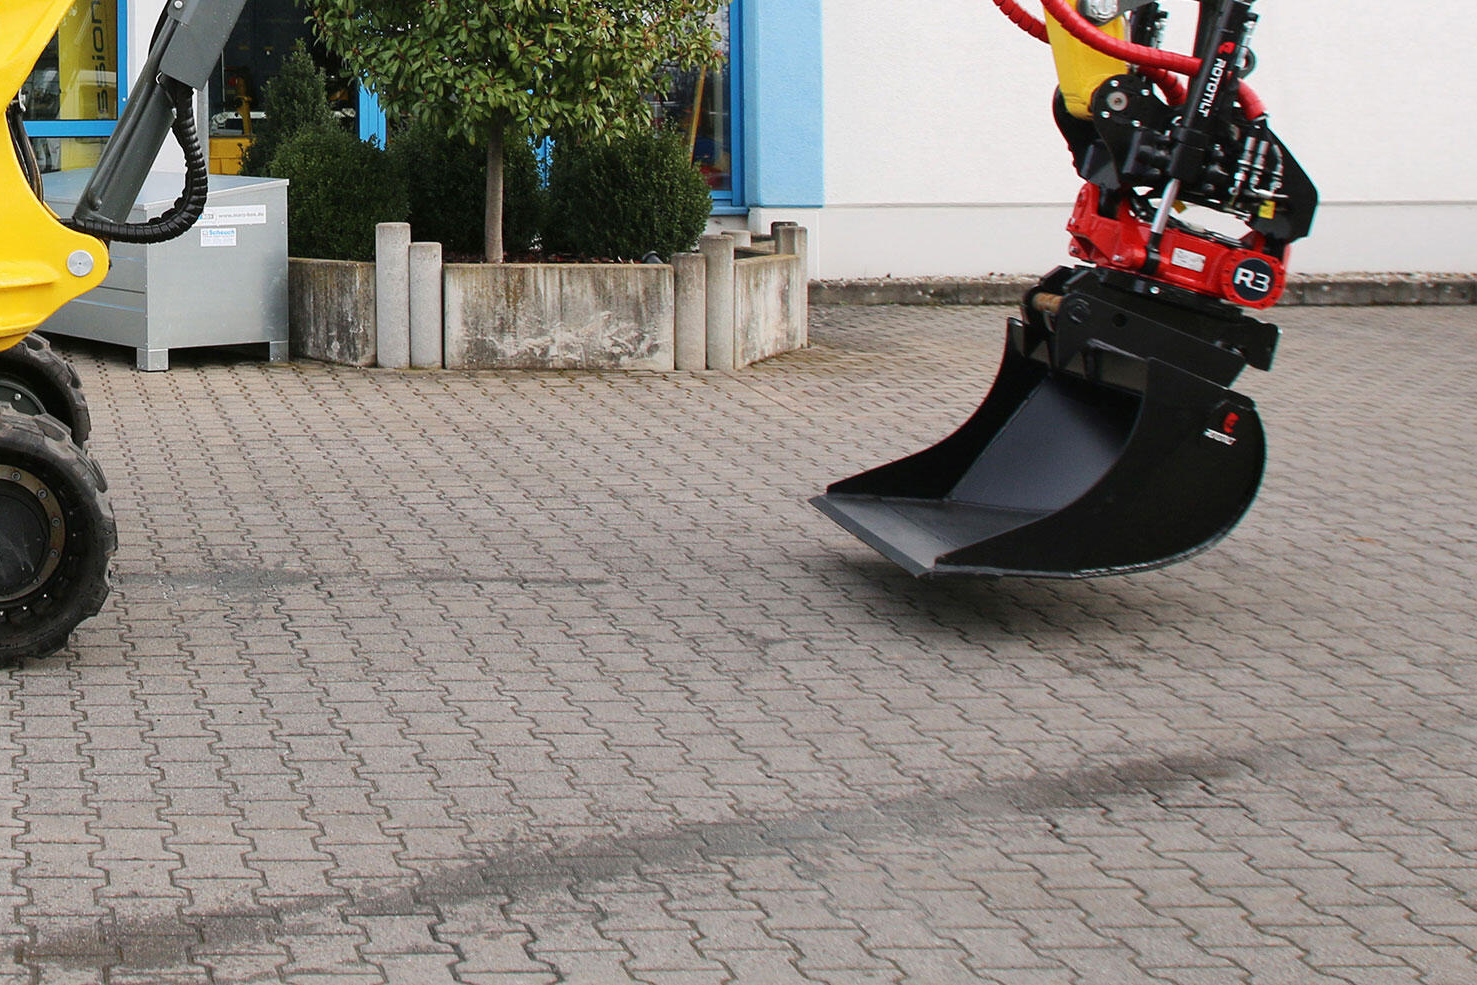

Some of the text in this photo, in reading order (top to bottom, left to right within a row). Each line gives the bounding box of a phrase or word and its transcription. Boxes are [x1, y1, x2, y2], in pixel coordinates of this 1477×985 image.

[91, 0, 109, 116] ssion
[1198, 58, 1227, 117] ROTOTILT
[1233, 267, 1271, 292] R3
